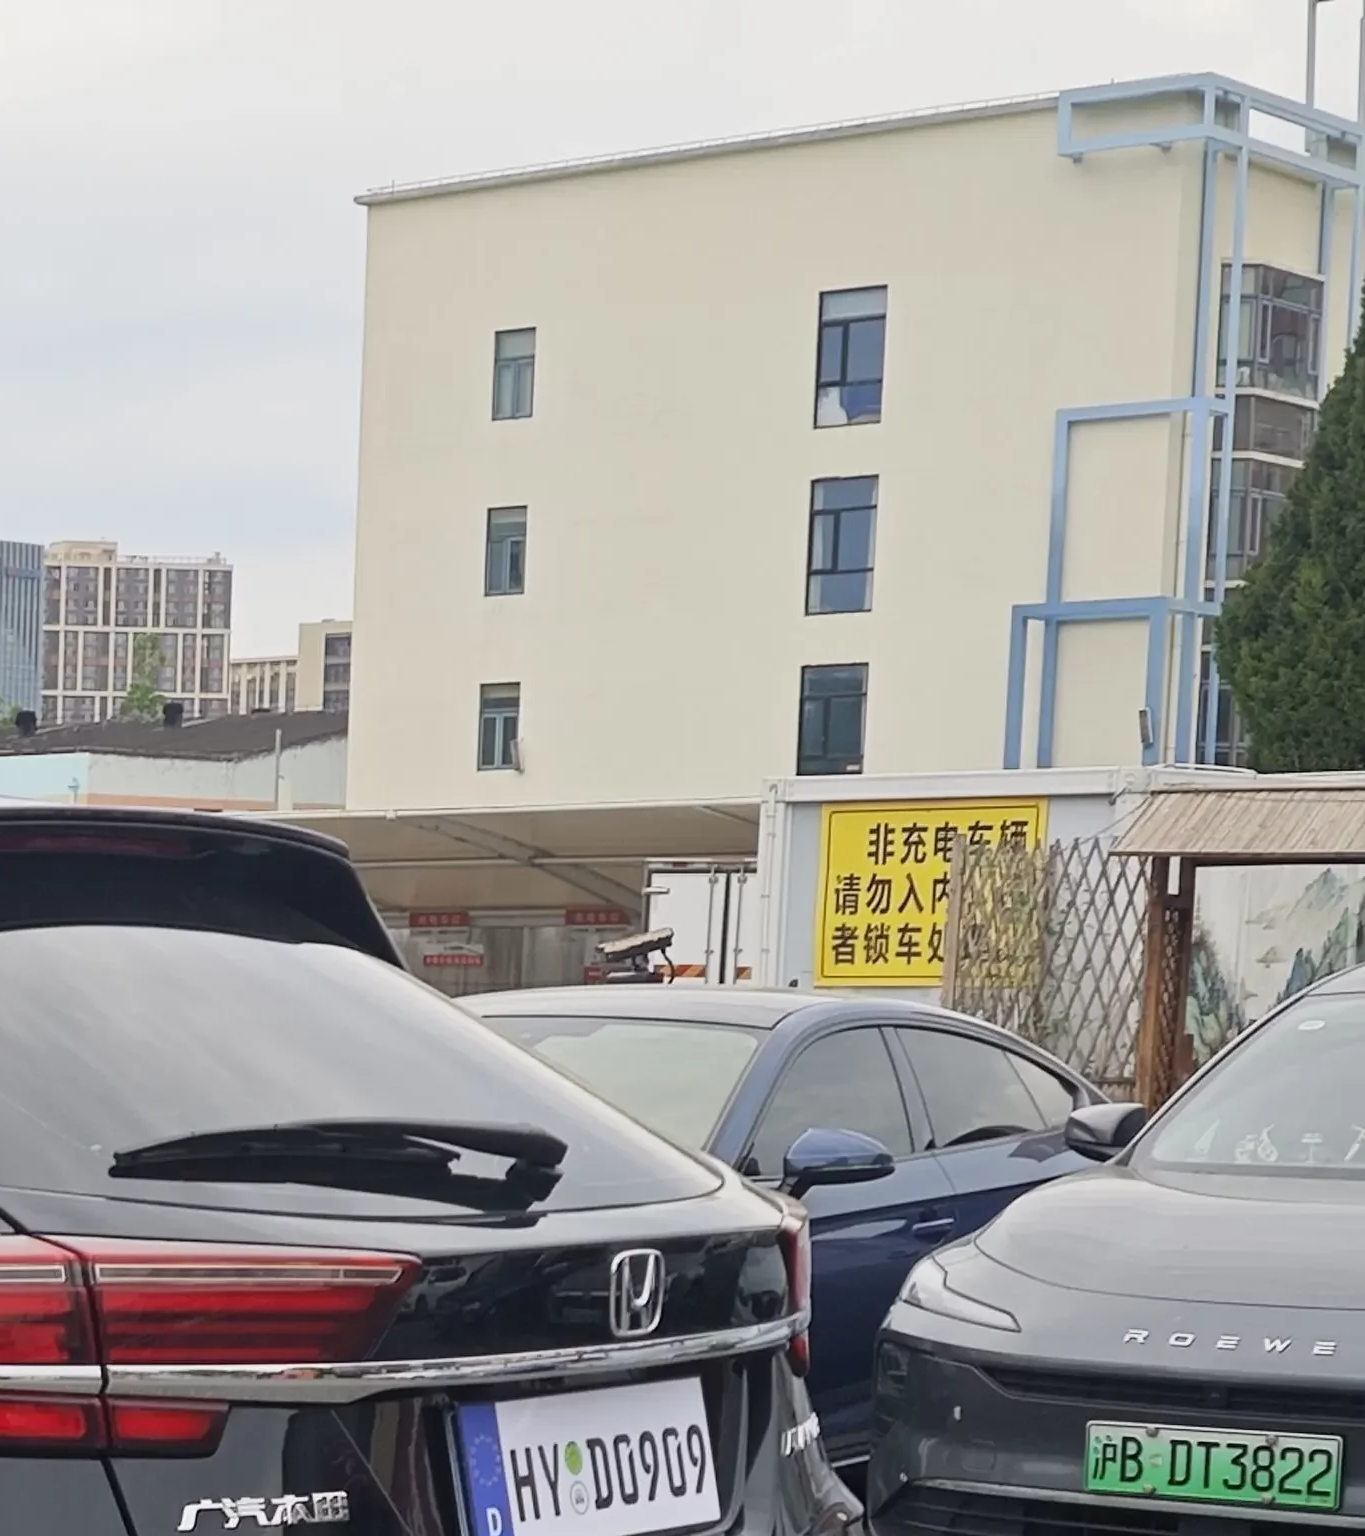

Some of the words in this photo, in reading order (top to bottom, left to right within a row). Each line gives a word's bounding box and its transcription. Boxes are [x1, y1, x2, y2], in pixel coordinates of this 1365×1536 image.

[1123, 1328, 1338, 1357] ROEWE
[510, 1443, 561, 1523] HY
[586, 1424, 707, 1511] D0909
[1169, 1438, 1333, 1498] DT3822
[177, 1490, 351, 1532] 广汽本田
